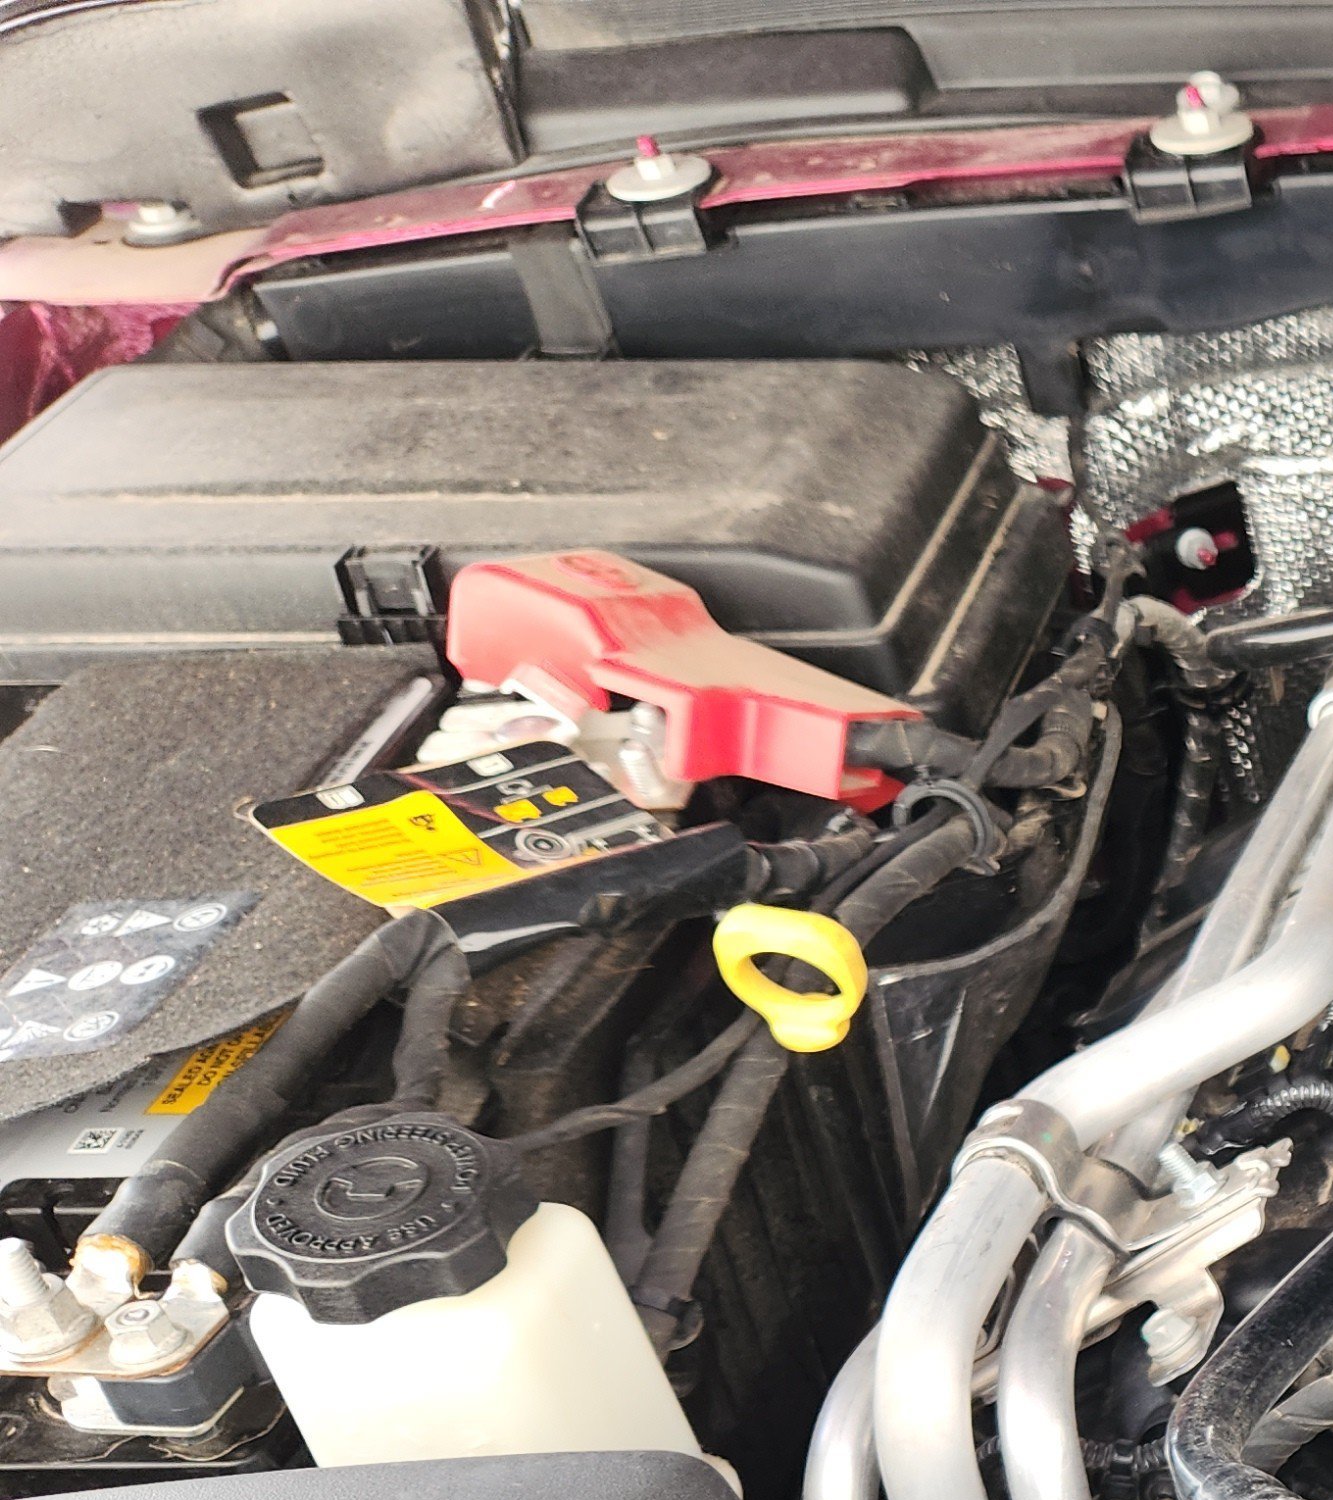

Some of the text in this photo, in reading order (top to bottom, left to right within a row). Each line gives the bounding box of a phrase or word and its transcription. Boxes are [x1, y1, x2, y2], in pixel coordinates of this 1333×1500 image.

[162, 1066, 202, 1105] SEALED
[197, 1070, 218, 1087] DO
[273, 1145, 332, 1187] FLUID
[265, 1212, 438, 1251] USE APPROVED
